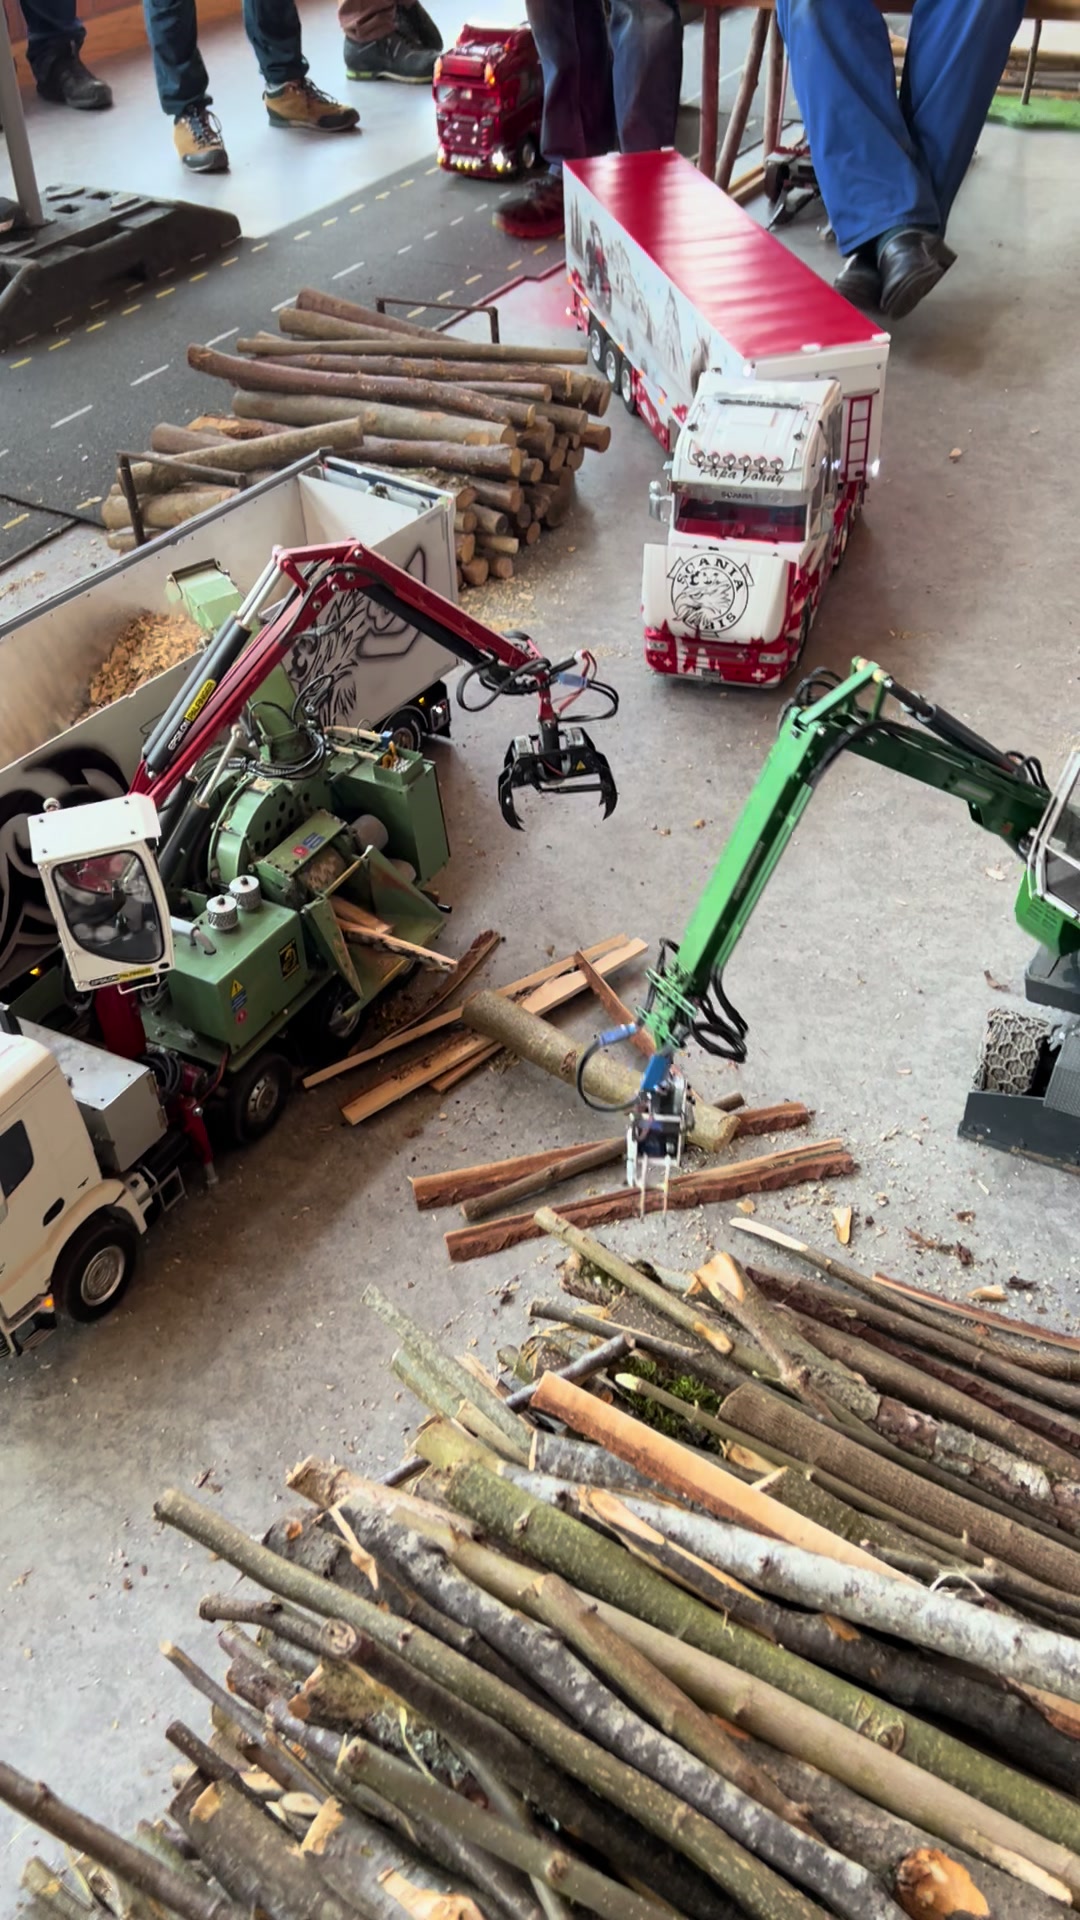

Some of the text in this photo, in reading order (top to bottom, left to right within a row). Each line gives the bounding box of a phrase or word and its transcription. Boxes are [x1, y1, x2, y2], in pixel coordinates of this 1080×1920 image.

[677, 557, 744, 592] SCANIA
[168, 681, 215, 751] EPSILON PALFINGER
